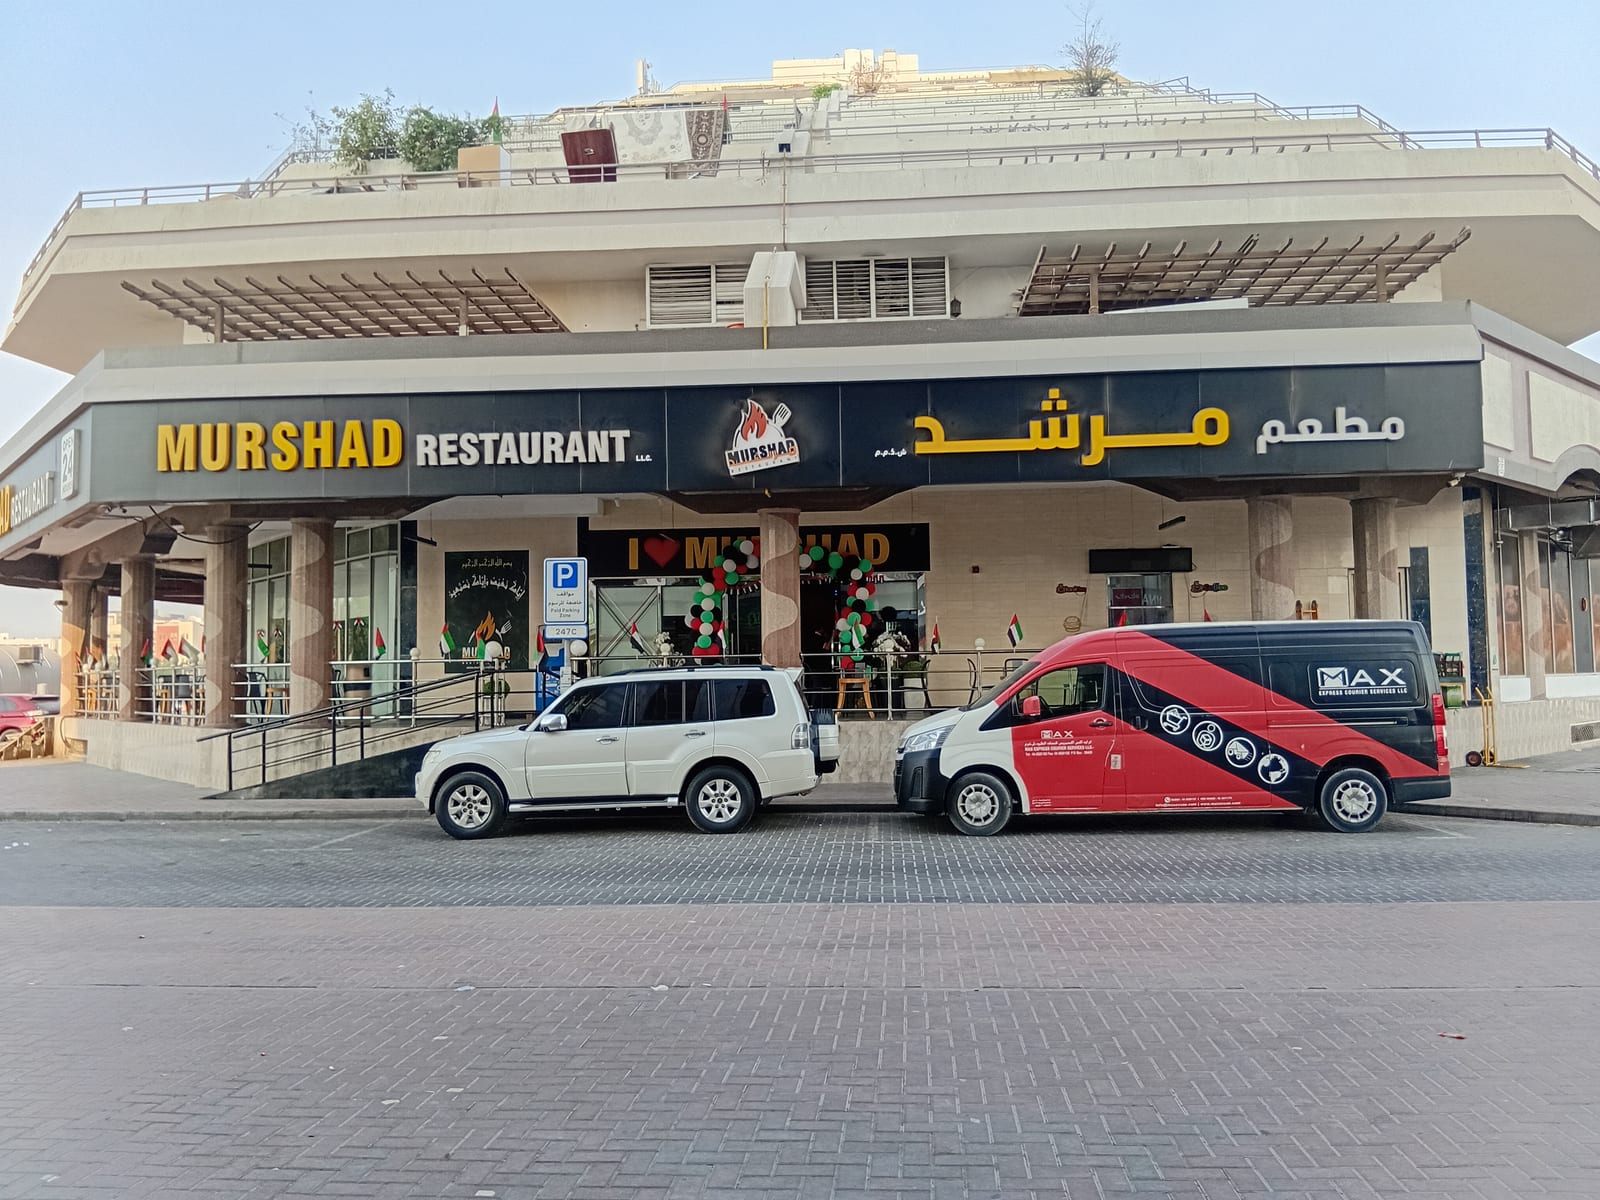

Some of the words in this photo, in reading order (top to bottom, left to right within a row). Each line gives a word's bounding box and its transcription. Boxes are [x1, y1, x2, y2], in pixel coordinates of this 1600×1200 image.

[157, 418, 403, 472] MURSHAD
[416, 429, 631, 467] RESTAURANT
[914, 388, 1230, 466] مرشد
[1256, 406, 1405, 455] مطعم
[727, 439, 797, 465] MURSHAD
[1317, 667, 1407, 687] MAX
[1041, 730, 1074, 739] MAX
